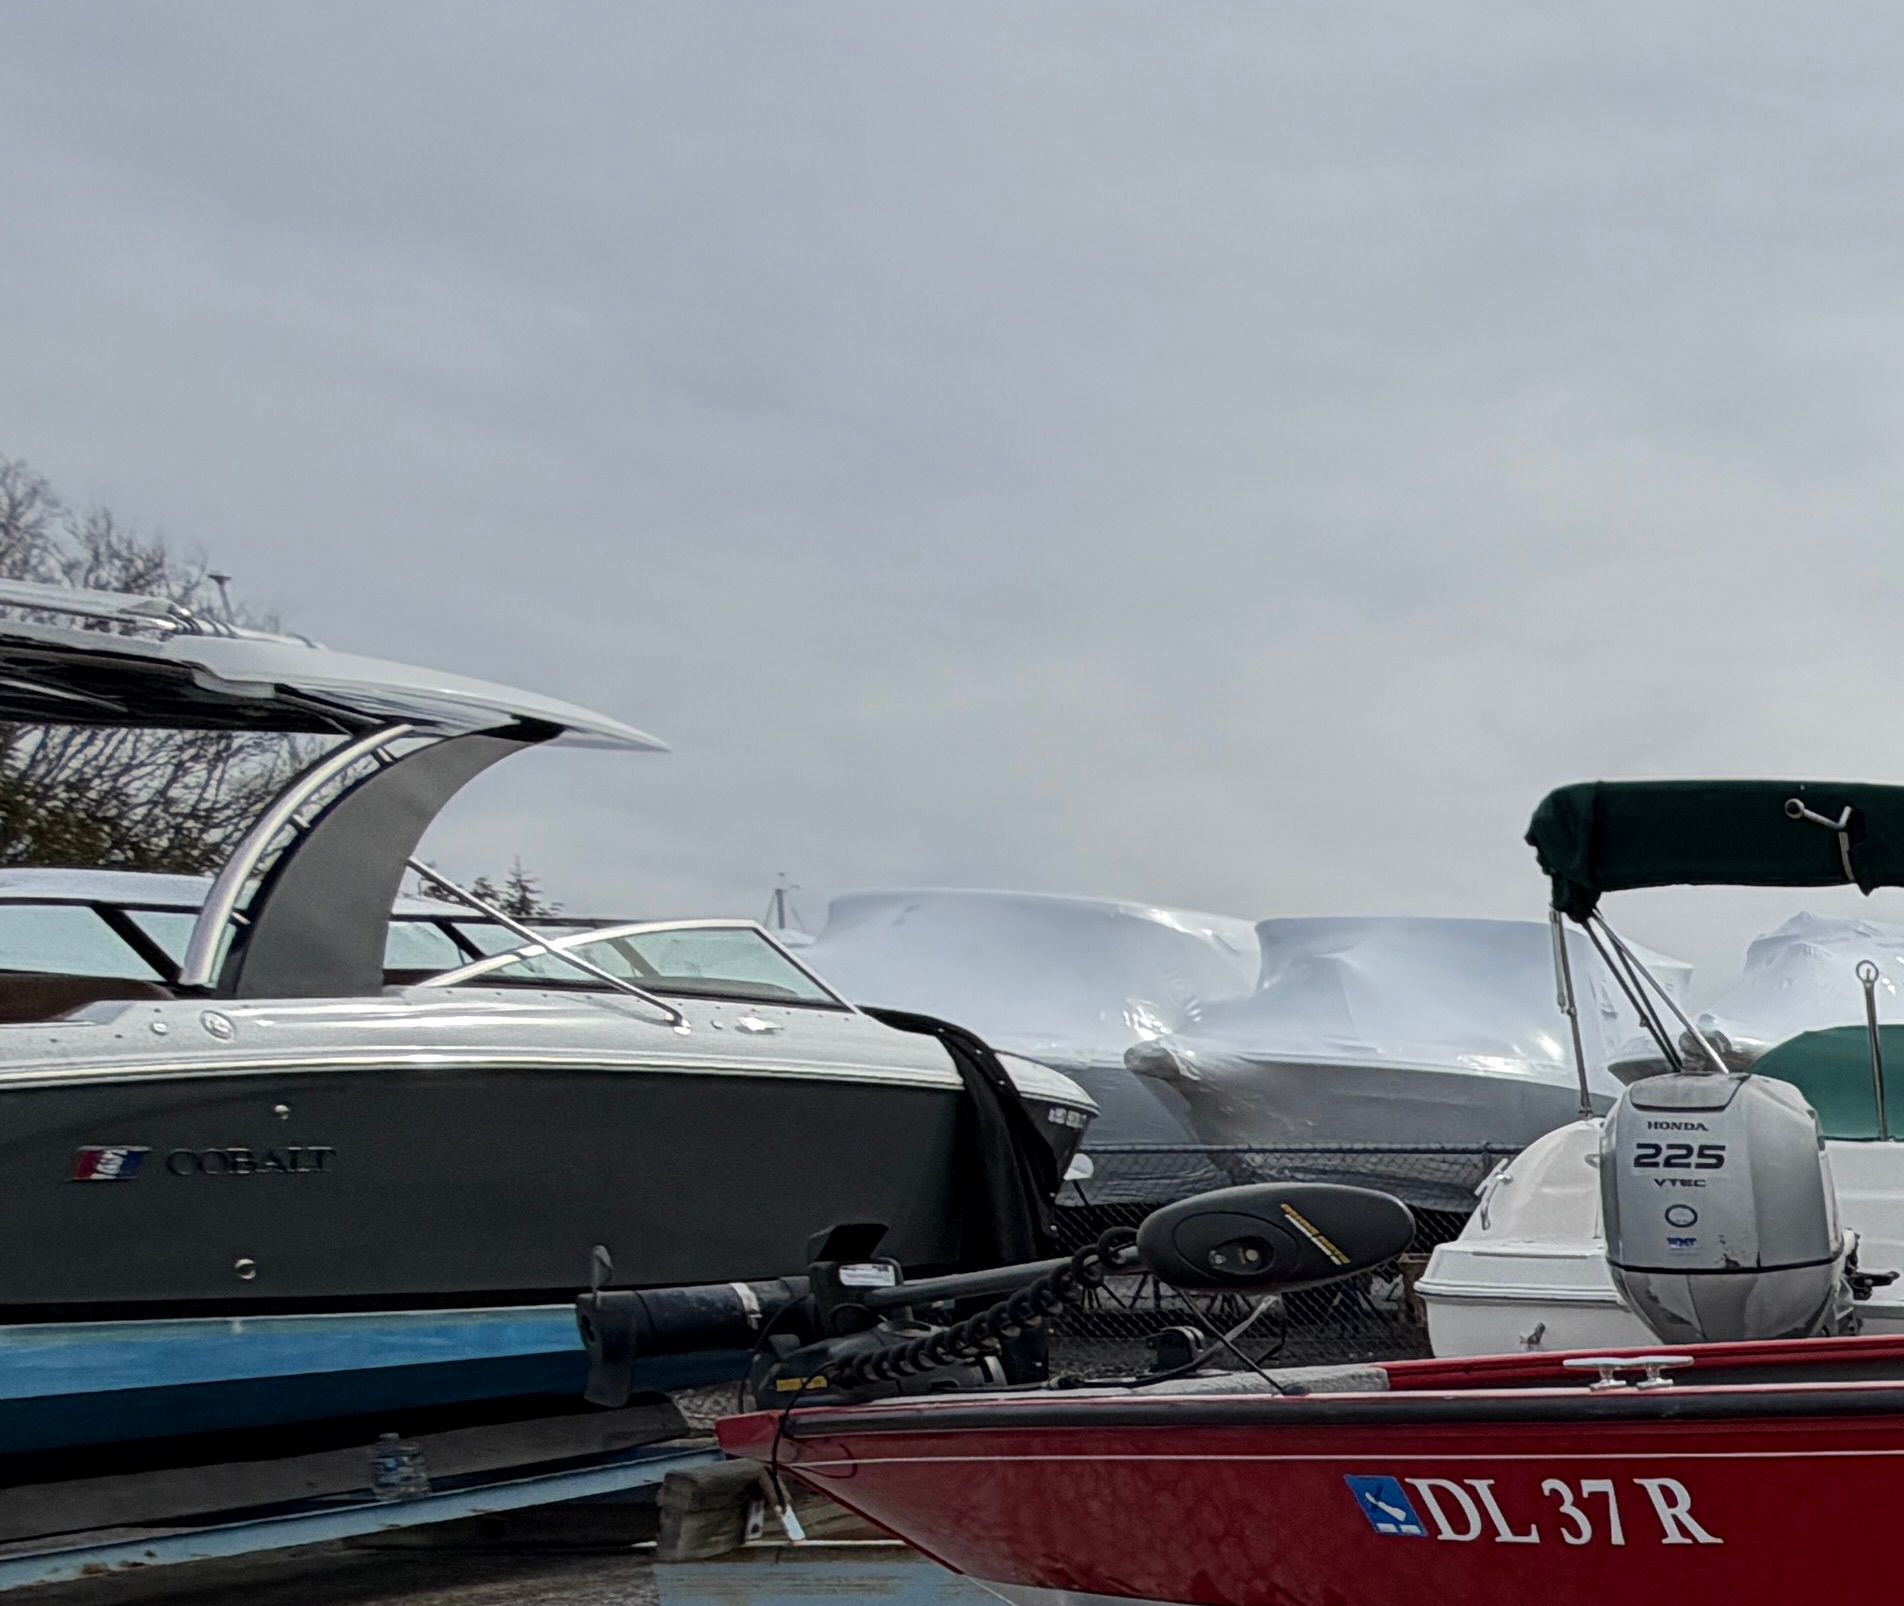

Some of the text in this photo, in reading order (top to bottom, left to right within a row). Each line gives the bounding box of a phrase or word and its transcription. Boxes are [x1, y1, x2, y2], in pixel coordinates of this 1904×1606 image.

[1647, 1121, 1709, 1131] HONDA
[166, 1147, 336, 1175] COBALT
[1633, 1142, 1726, 1169] 225
[1653, 1178, 1706, 1187] VTEC
[1405, 1477, 1724, 1545] DL 37 R
